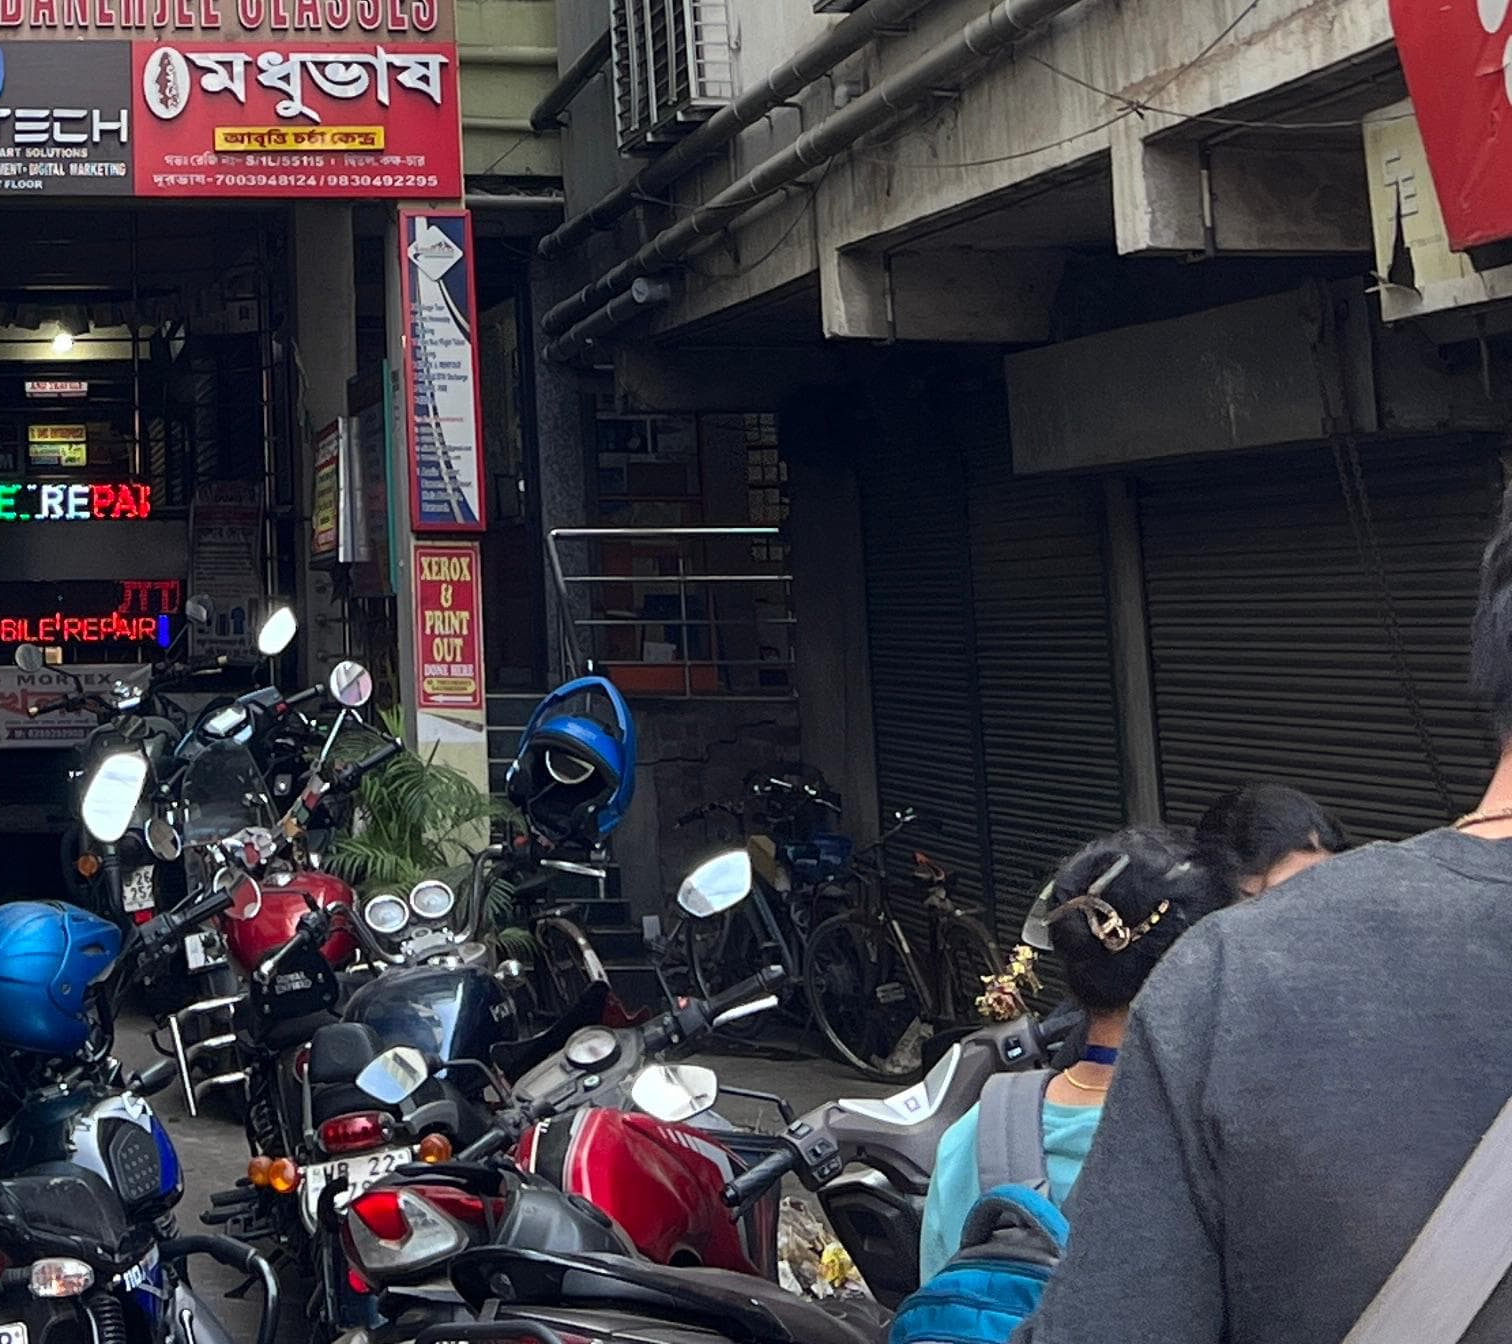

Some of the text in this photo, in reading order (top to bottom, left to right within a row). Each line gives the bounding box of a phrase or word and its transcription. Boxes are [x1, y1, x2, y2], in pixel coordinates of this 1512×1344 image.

[185, 45, 449, 123] মধুভাষ
[330, 129, 378, 147] কেন্দ্র
[25, 147, 89, 159] SOLUTIONS
[29, 163, 66, 177] DIGITAL
[69, 163, 127, 177] MARKETING
[4, 180, 43, 190] FLOOR
[420, 555, 471, 582] XEROX
[63, 612, 157, 642] REPAIR
[424, 610, 470, 636] PRINT
[432, 637, 464, 663] OUT
